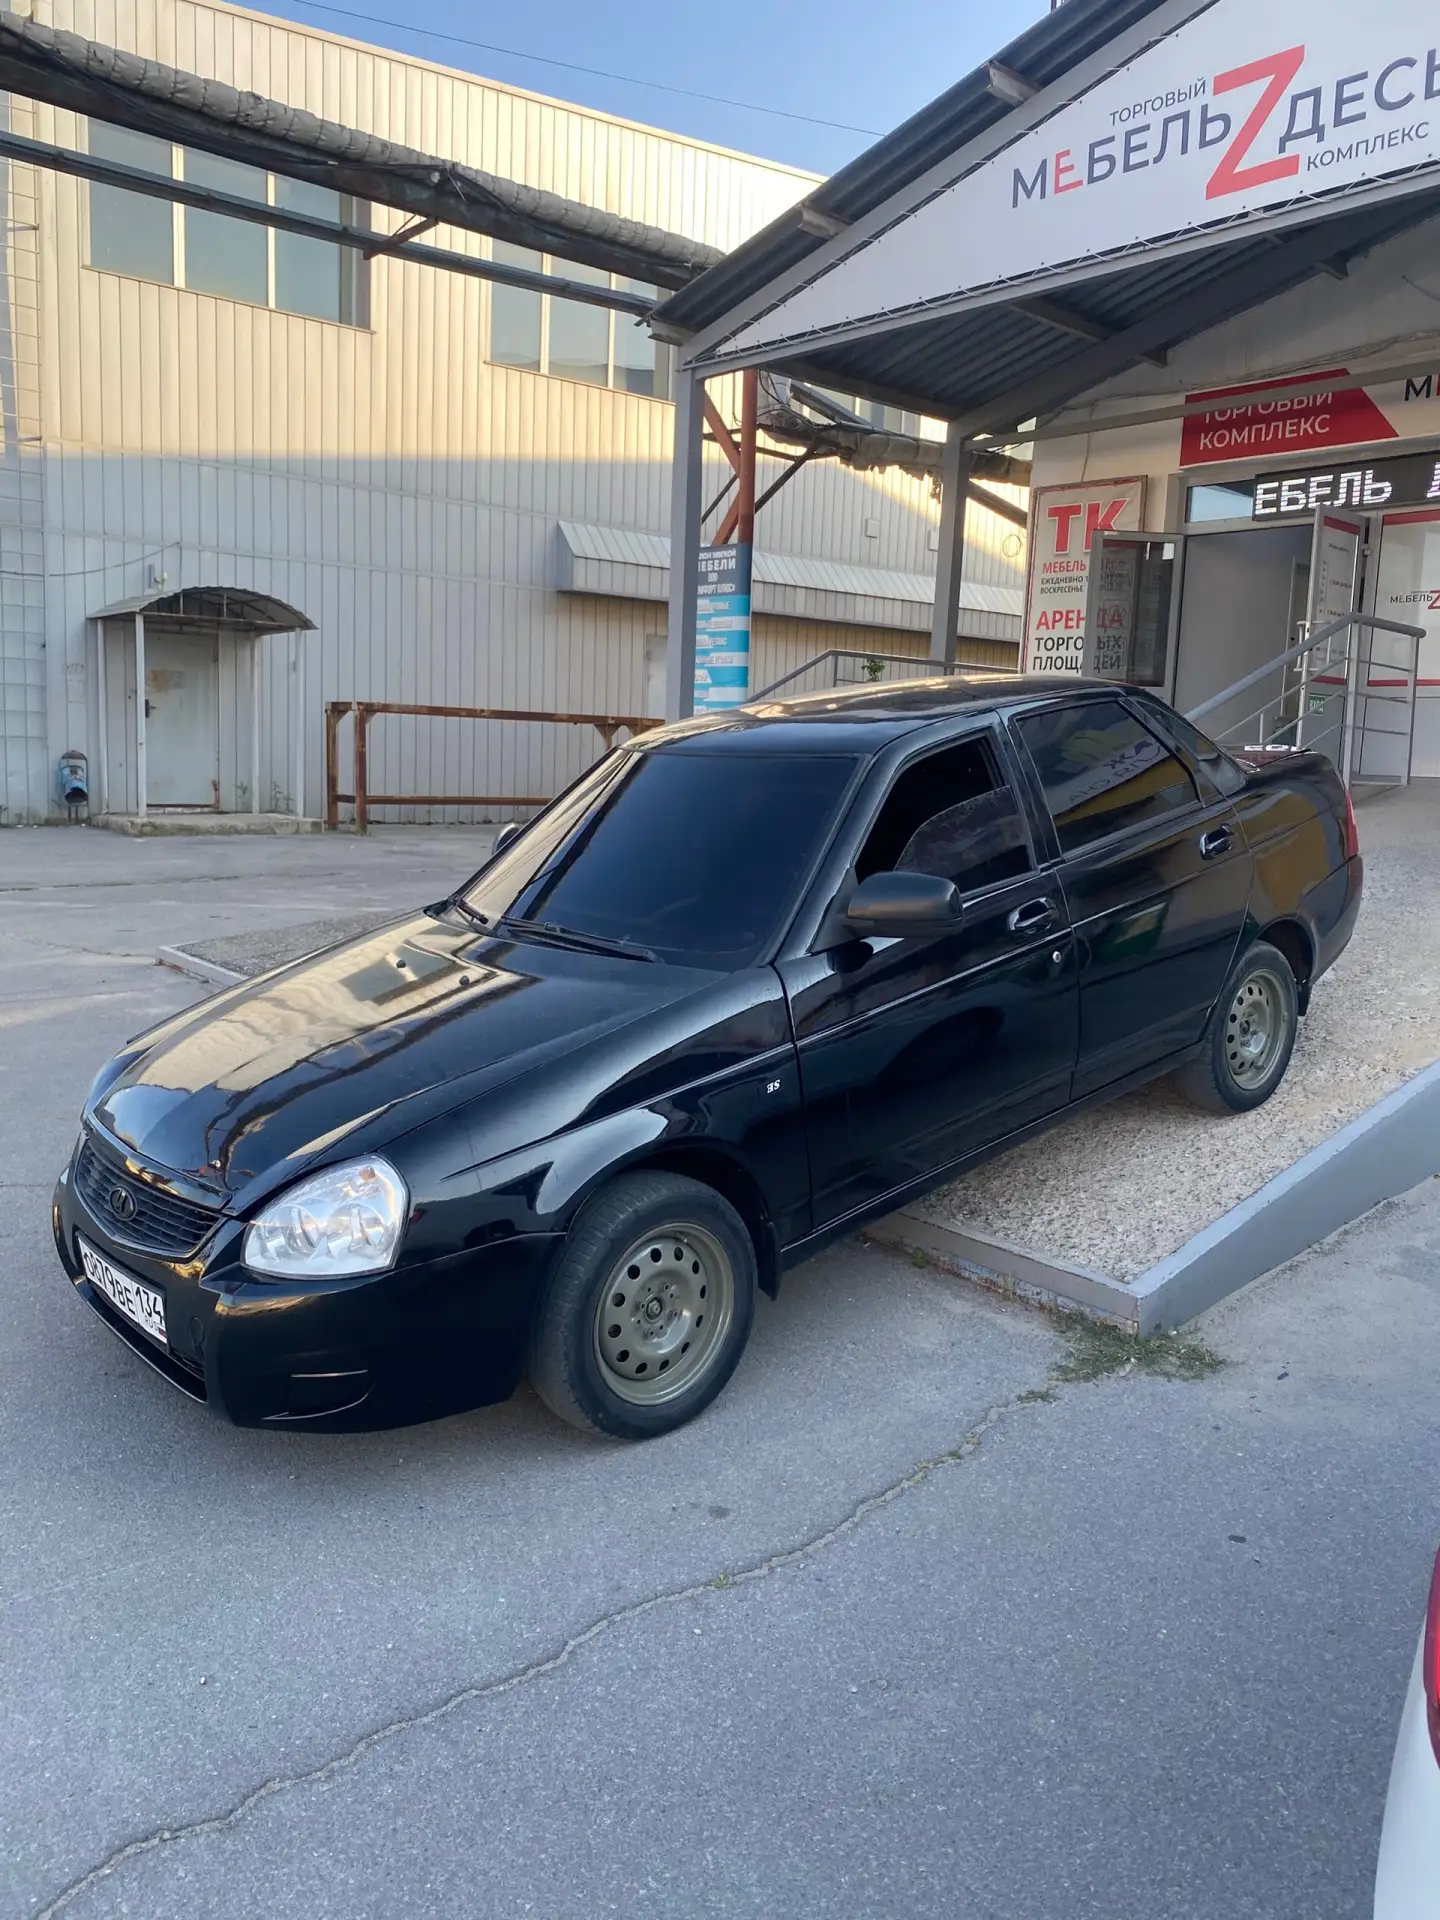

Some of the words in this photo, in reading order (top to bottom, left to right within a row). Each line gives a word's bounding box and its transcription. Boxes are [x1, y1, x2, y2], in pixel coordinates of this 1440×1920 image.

[1109, 77, 1206, 126] ТОРГОВЫЙ
[1307, 121, 1429, 171] КОМПЛЕКС
[1199, 414, 1331, 450] КОМПЛЕКС
[1254, 469, 1393, 515] ЕБЕЛЬ
[1047, 498, 1129, 555] ТК
[1042, 560, 1087, 574] МЕБЕЛЬ
[1040, 585, 1083, 594] ВОСКРЕСЕНЬЕ
[1041, 575, 1084, 585] ЕЖЕДНЕВНО
[1390, 594, 1432, 604] МЕБЕЛЬ
[1035, 636, 1122, 651] ТОРГОЫХ
[1032, 653, 1121, 674] ПЛОЩДЕЙ
